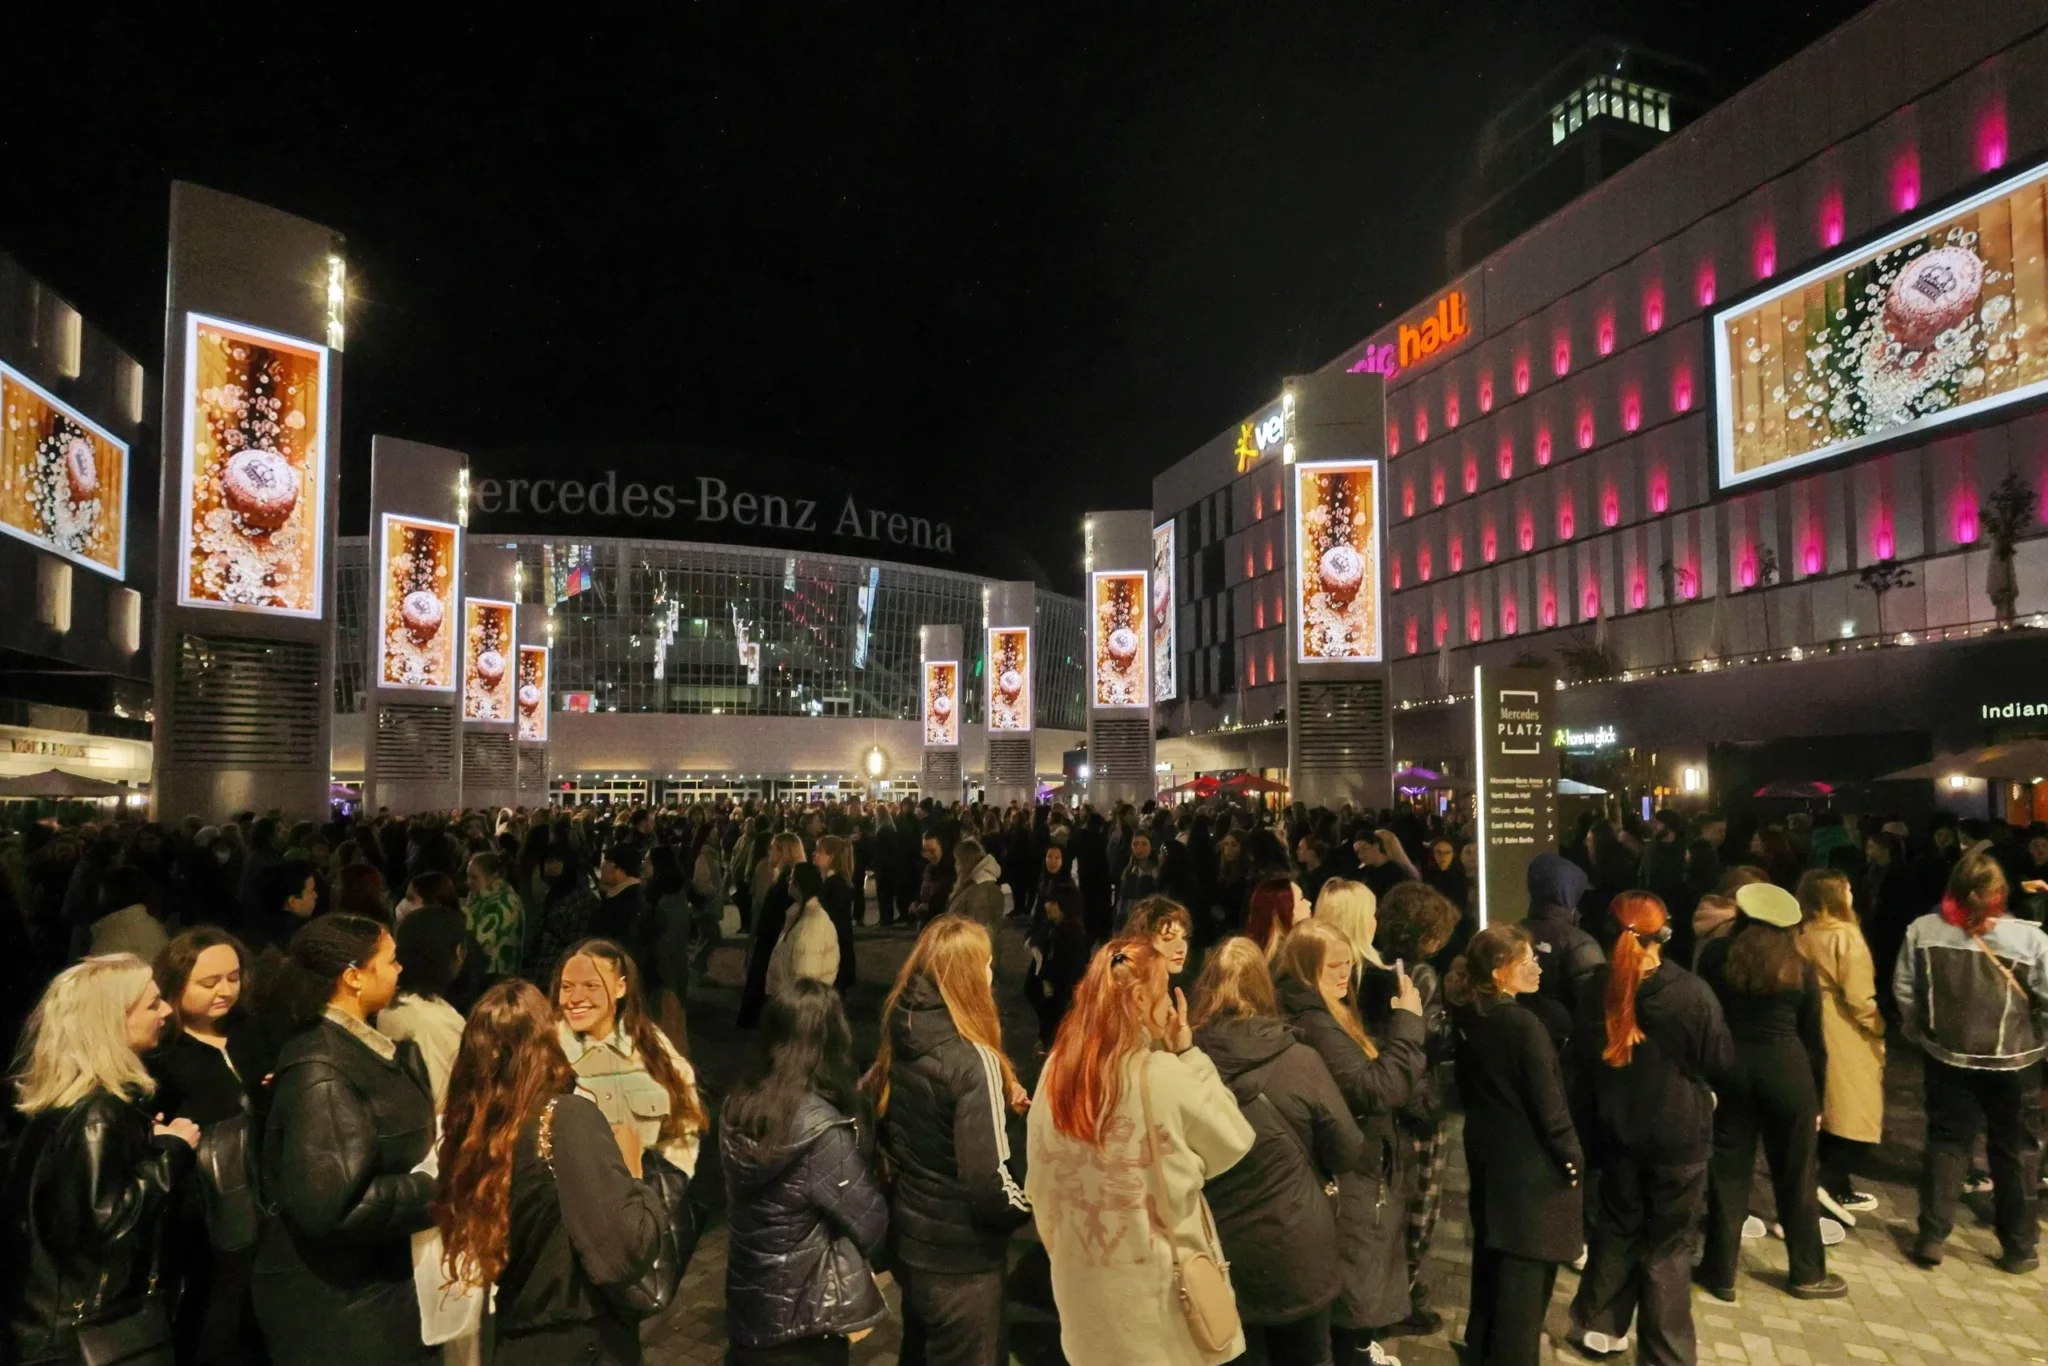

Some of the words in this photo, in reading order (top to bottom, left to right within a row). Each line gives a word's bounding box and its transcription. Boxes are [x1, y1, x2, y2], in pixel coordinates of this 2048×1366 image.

[1347, 343, 1395, 377] ic
[1400, 291, 1467, 367] hall
[476, 470, 817, 532] ercedes-Benz
[832, 495, 955, 553] Arena
[1500, 707, 1540, 721] Mercedes
[1982, 702, 2048, 719] Indian
[1498, 723, 1543, 736] PLATZ
